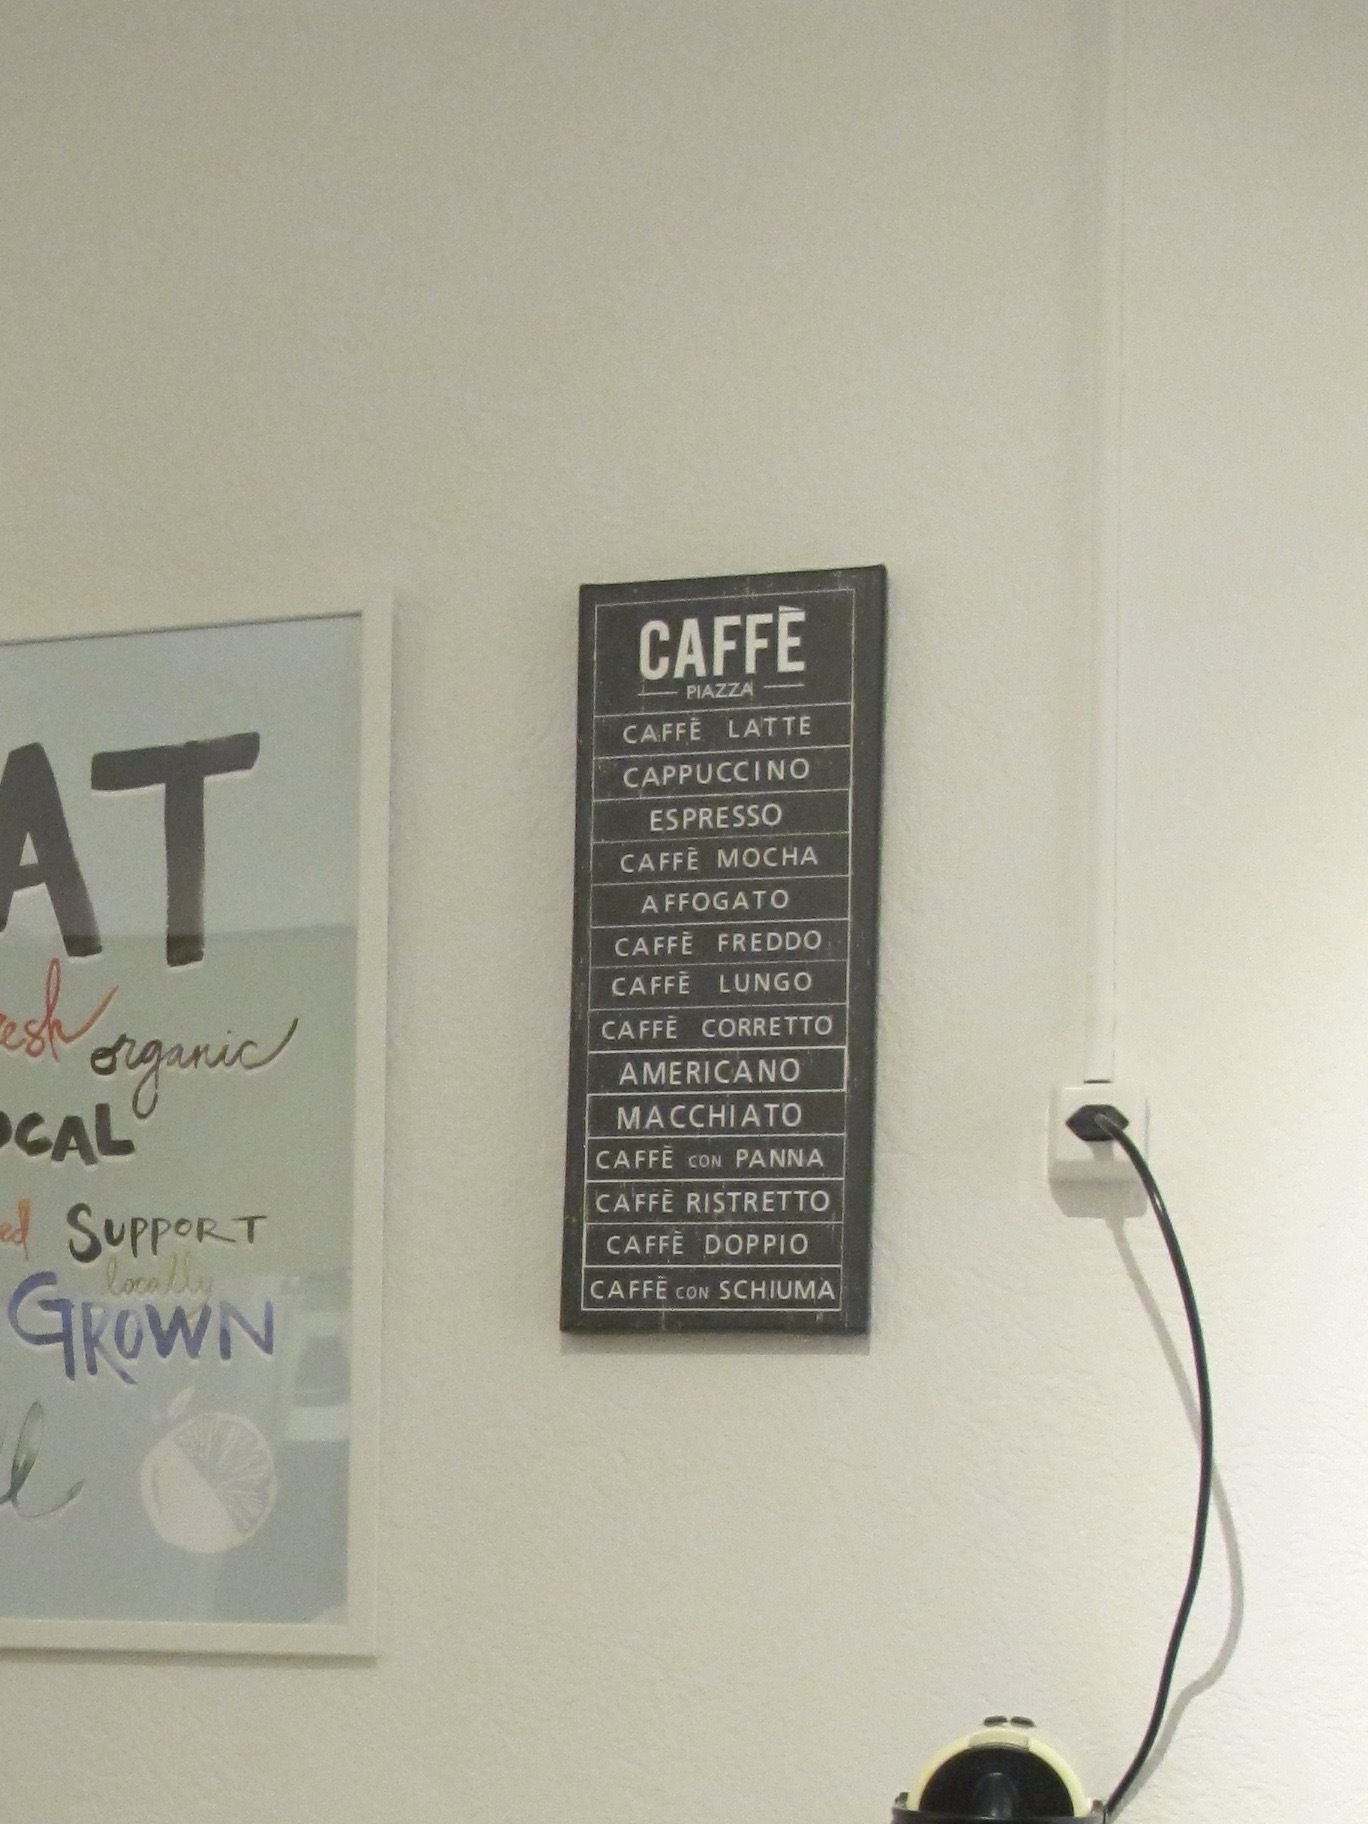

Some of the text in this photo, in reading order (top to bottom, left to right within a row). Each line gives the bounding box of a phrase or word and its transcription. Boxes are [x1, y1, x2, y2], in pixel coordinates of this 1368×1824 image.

[639, 605, 806, 680] CAFFÈ
[687, 682, 753, 700] PIAZZA
[623, 716, 811, 744] CAFFÈ LATTE
[624, 758, 809, 788] CAPPUCCINO
[650, 803, 782, 831] ESPRESSO
[620, 846, 818, 873] CAFFÈ MOCHA
[642, 889, 789, 914] AFFOGATO
[615, 930, 822, 957] CAFFÈ FREDDO
[612, 971, 812, 997] CAFFÈ LUNGO
[602, 1015, 832, 1041] CAFFÈ CORRETTO
[91, 1017, 298, 1120] organic
[619, 1058, 800, 1086] AMERICANO
[617, 1102, 802, 1130] MACCHIATO
[596, 1145, 823, 1170] CAFFÈ CON PANNA
[595, 1188, 830, 1214] CAFFÈ RISTRETTO
[66, 1203, 267, 1264] SUPPORT
[607, 1230, 809, 1255] CAFFÈ DOPPIO
[590, 1276, 836, 1300] CAFFÈ CON SCHIUMA
[8, 1271, 274, 1384] GROWN
